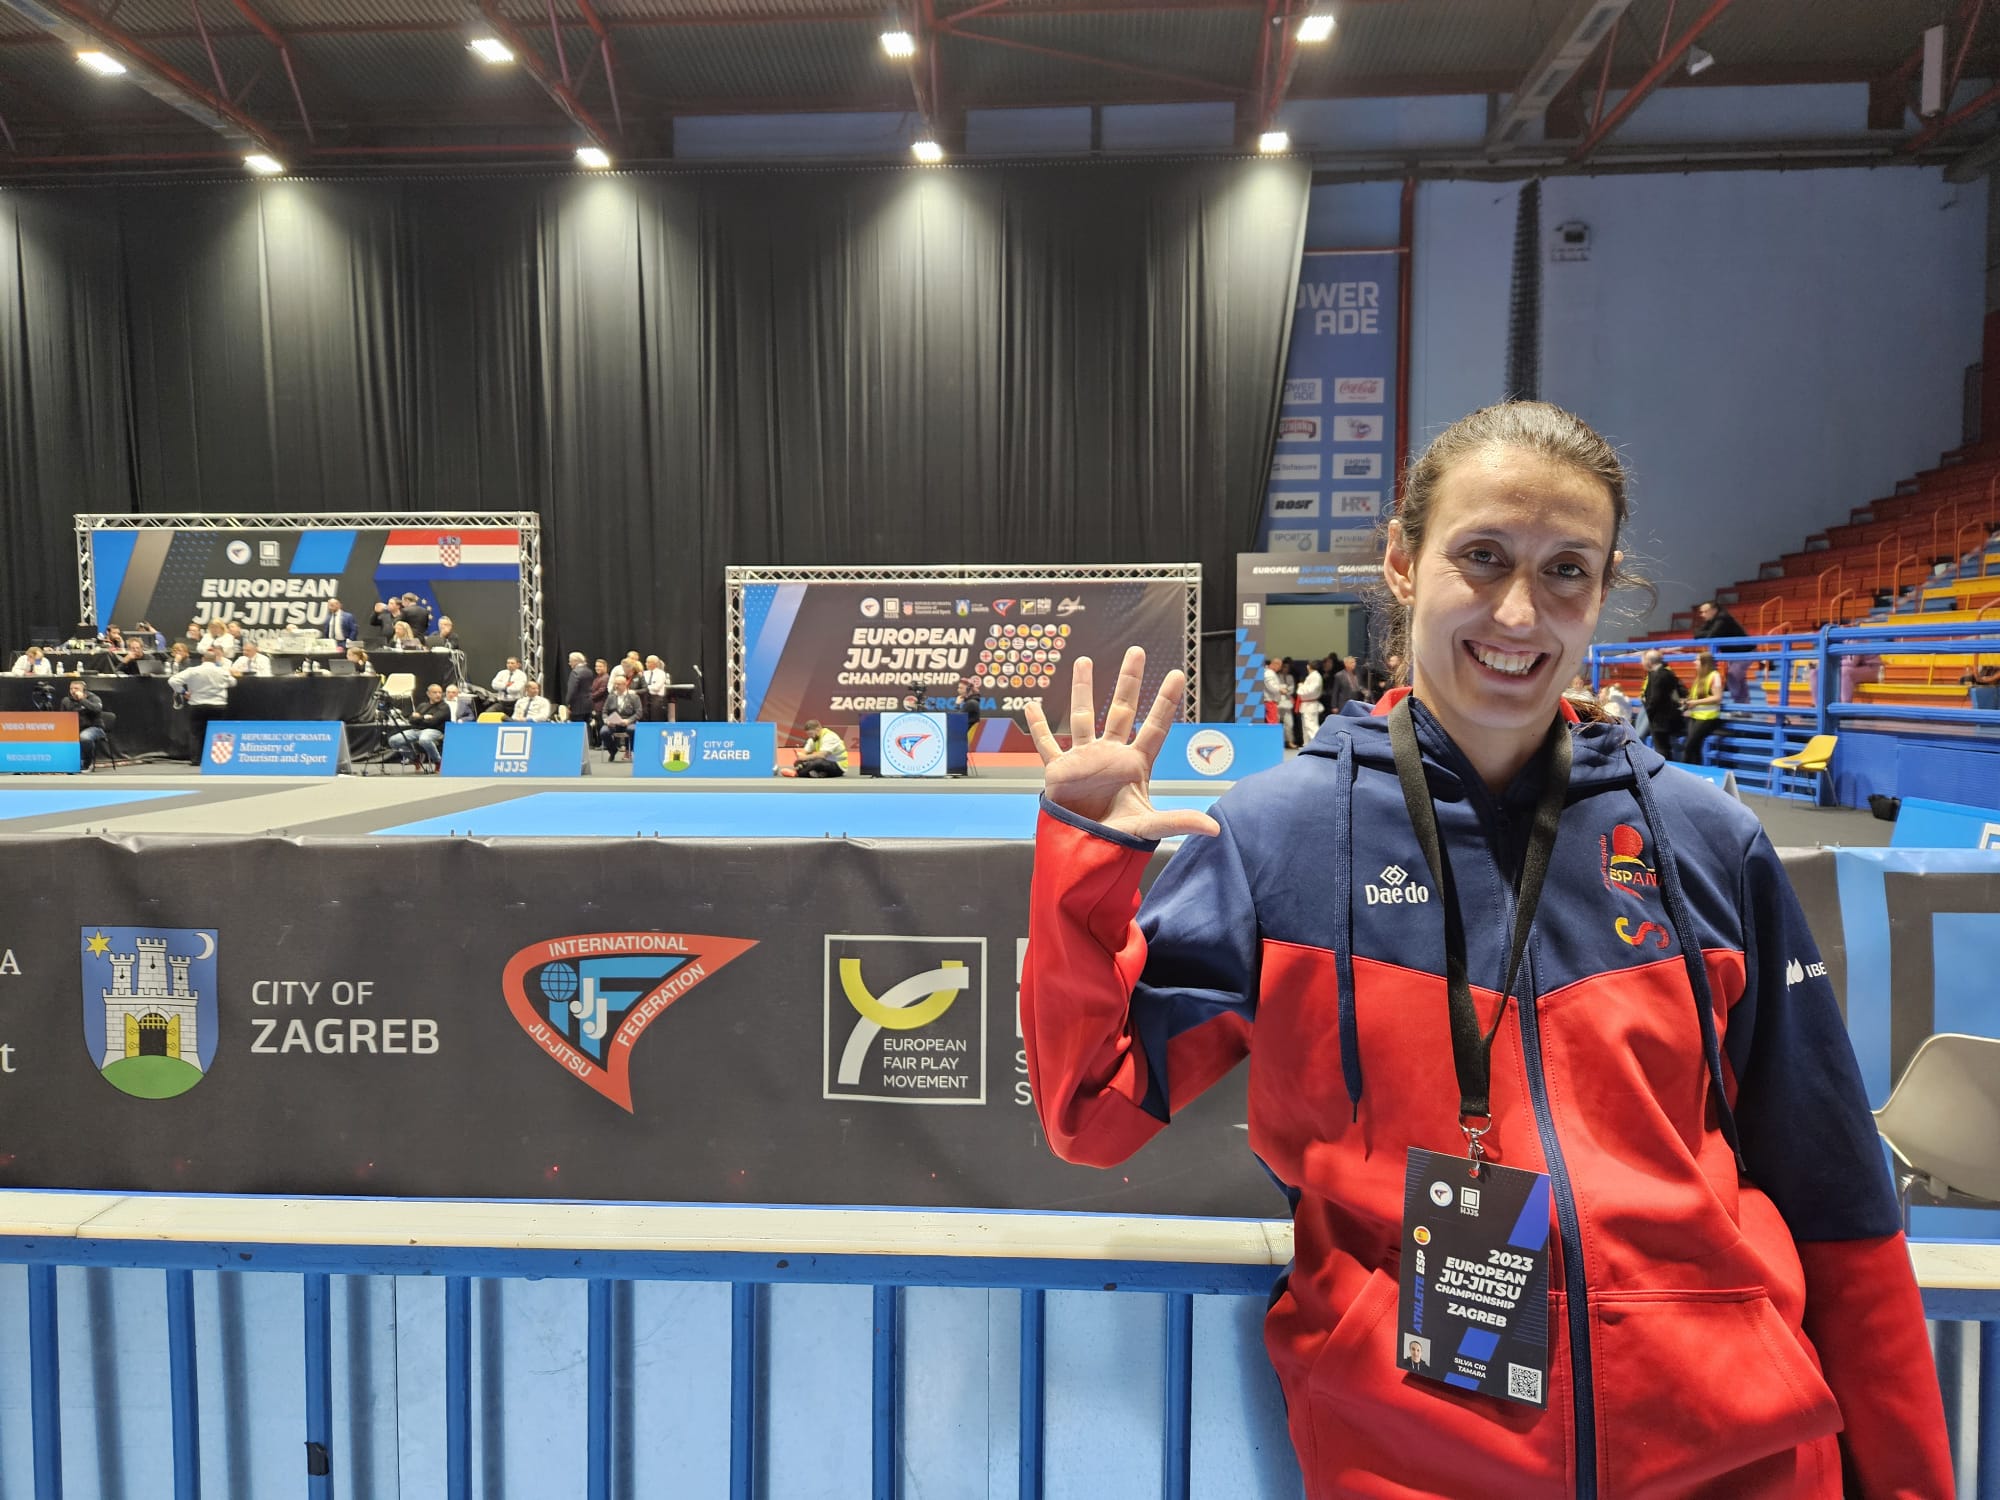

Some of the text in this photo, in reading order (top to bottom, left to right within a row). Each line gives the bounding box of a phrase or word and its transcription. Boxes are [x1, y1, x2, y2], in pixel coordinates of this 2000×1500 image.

[1297, 281, 1379, 309] WER
[1315, 308, 1379, 335] ADE
[1252, 566, 1300, 574] EUROPEAN
[201, 578, 339, 598] EUROPEAN
[192, 601, 329, 625] JU-JITSU
[852, 628, 976, 645] EUROPEAN
[843, 648, 969, 670] JU-JITSU
[837, 672, 960, 685] CHAMPIONSHIP
[829, 697, 898, 710] ZAGREB
[925, 697, 997, 710] CROIA
[239, 742, 296, 753] Ministry of
[703, 750, 750, 760] ZAGREB
[238, 753, 328, 765] Tourism and Sport
[493, 761, 528, 773] HJJS
[548, 935, 688, 957] INTERNATIONAL
[251, 980, 375, 1005] CITY OF
[617, 963, 705, 1047] FEDERATION
[250, 1018, 440, 1054] ZAGREB
[883, 1039, 967, 1051] EUROPEAN
[528, 1023, 593, 1078] JU-JITSU
[883, 1057, 959, 1070] FAIR PLAY
[883, 1075, 968, 1088] MOVEMENT
[1445, 1256, 1527, 1286] EUROPEAN
[1487, 1249, 1534, 1272] 2023
[1412, 1249, 1426, 1334] ATHLETE ESP
[1439, 1269, 1521, 1300] JU-JITSU
[1434, 1283, 1516, 1310] CHAMPIONSHIP
[1447, 1302, 1507, 1328] ZAGREB
[1454, 1357, 1487, 1371] SILVA CID
[1458, 1365, 1486, 1379] TAMARA
